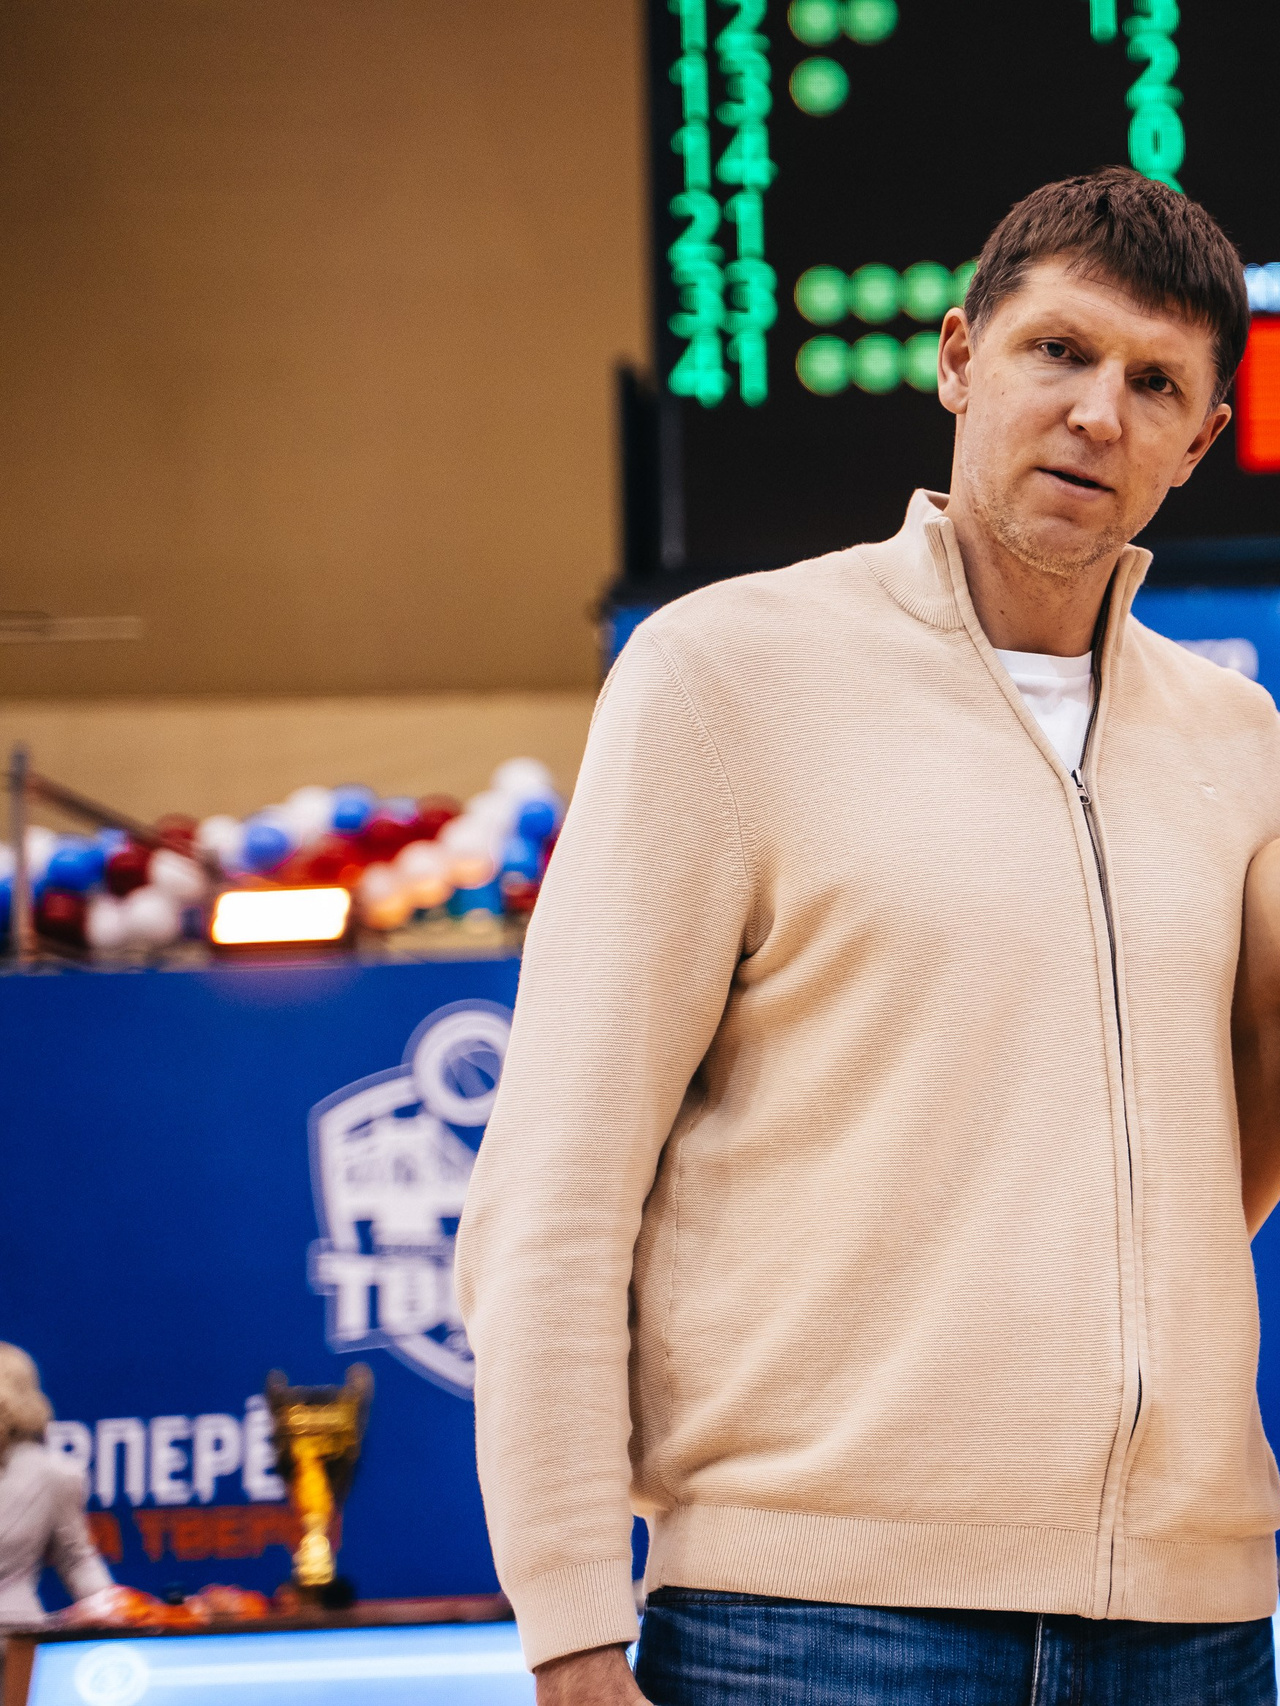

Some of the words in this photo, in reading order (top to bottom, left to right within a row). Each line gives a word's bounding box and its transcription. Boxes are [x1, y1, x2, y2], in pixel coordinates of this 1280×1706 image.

[668, 50, 773, 127] 13
[670, 120, 780, 192] 14
[666, 189, 765, 262] 21
[667, 330, 772, 408] 41
[45, 1394, 288, 1508] ВПЕРЁ
